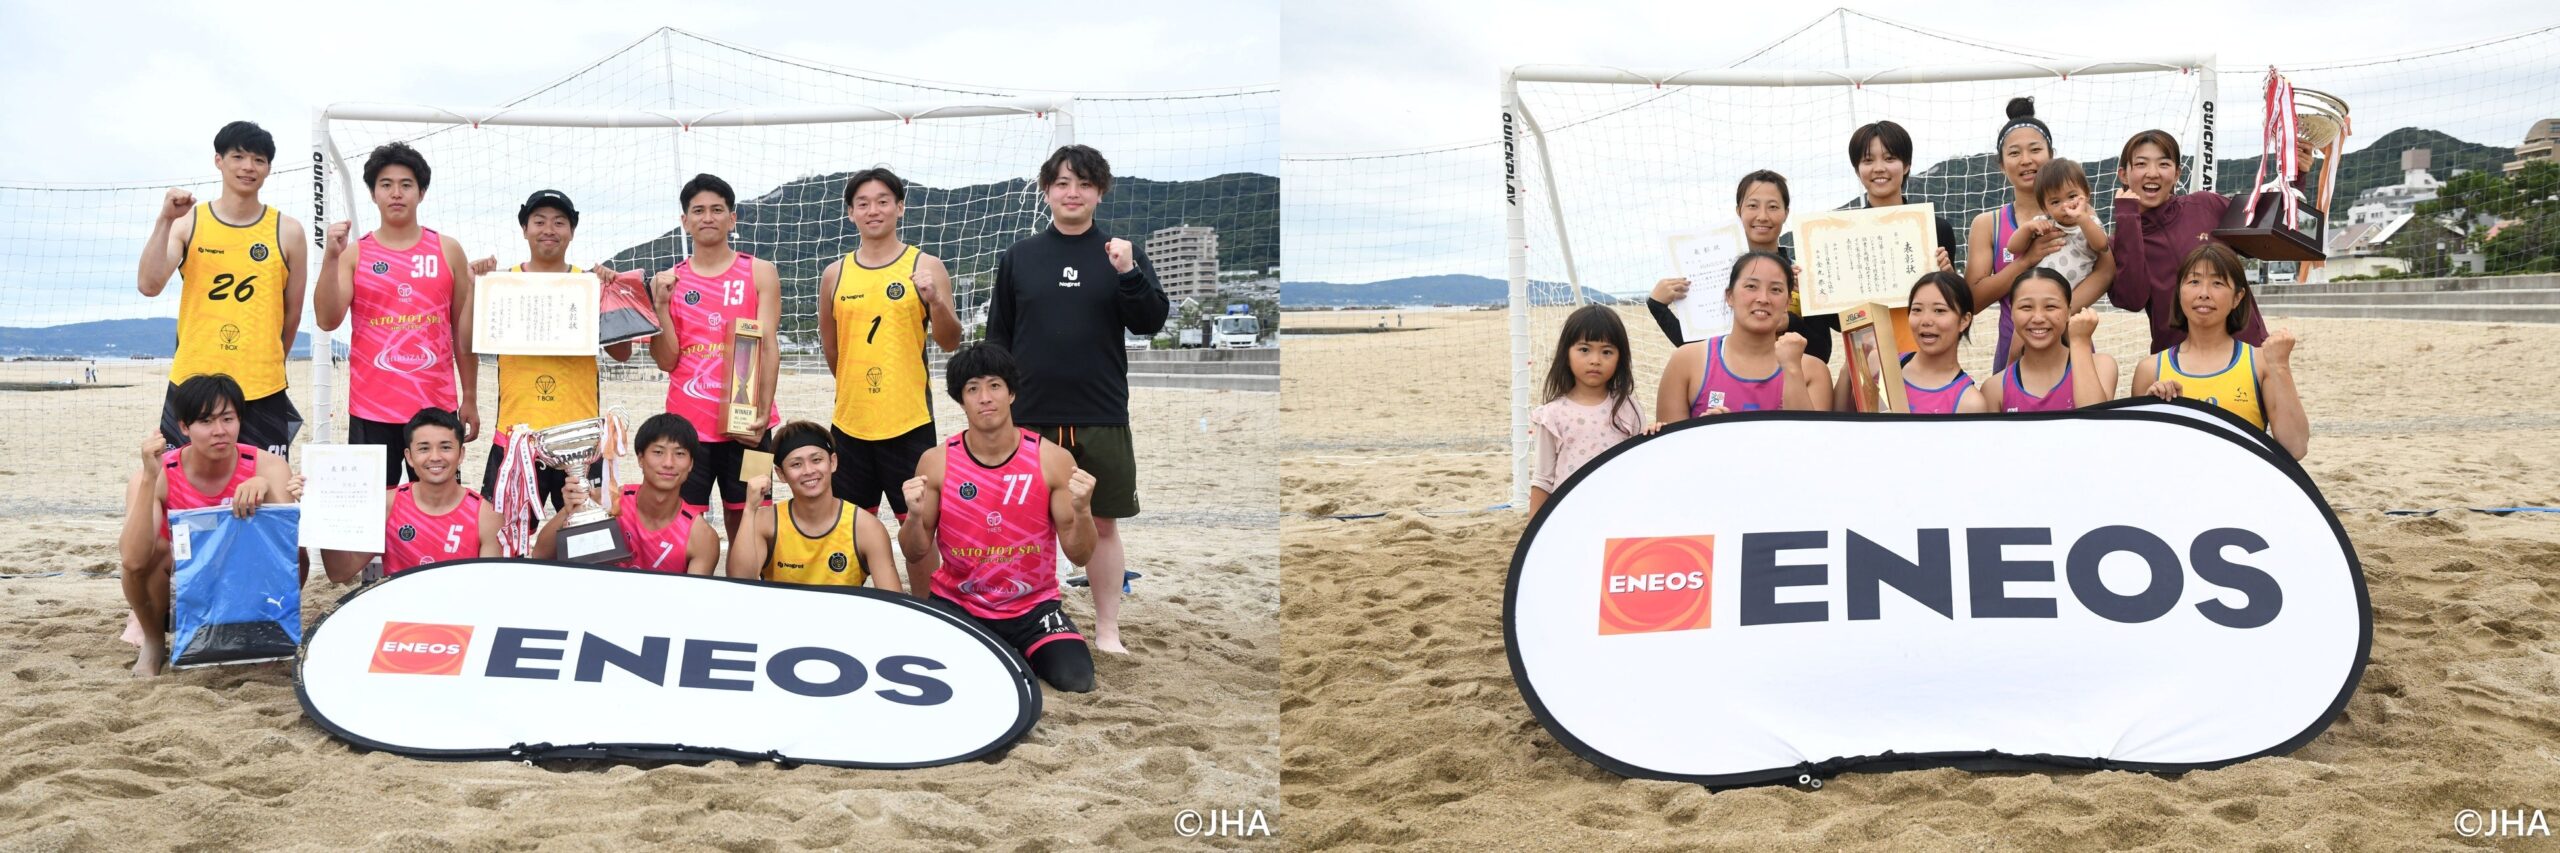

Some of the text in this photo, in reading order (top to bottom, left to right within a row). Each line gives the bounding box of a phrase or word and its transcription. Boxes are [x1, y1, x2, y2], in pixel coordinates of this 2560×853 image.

[1502, 112, 1516, 206] QUICKPLAY
[313, 151, 324, 249] QUICKPLAY
[410, 255, 438, 278] 30
[1904, 242, 1917, 274] 表彰状
[208, 273, 258, 302] 26
[723, 279, 745, 306] 13
[866, 315, 882, 344] 1
[1002, 474, 1033, 505] 77
[444, 524, 464, 553] 5
[951, 544, 1041, 557] SATO HOT SPA
[652, 541, 673, 568] 7
[1608, 571, 1704, 593] ENEOS
[1740, 525, 2283, 629] ENEOS
[382, 641, 461, 655] ENEOS
[485, 627, 954, 706] ENEOS
